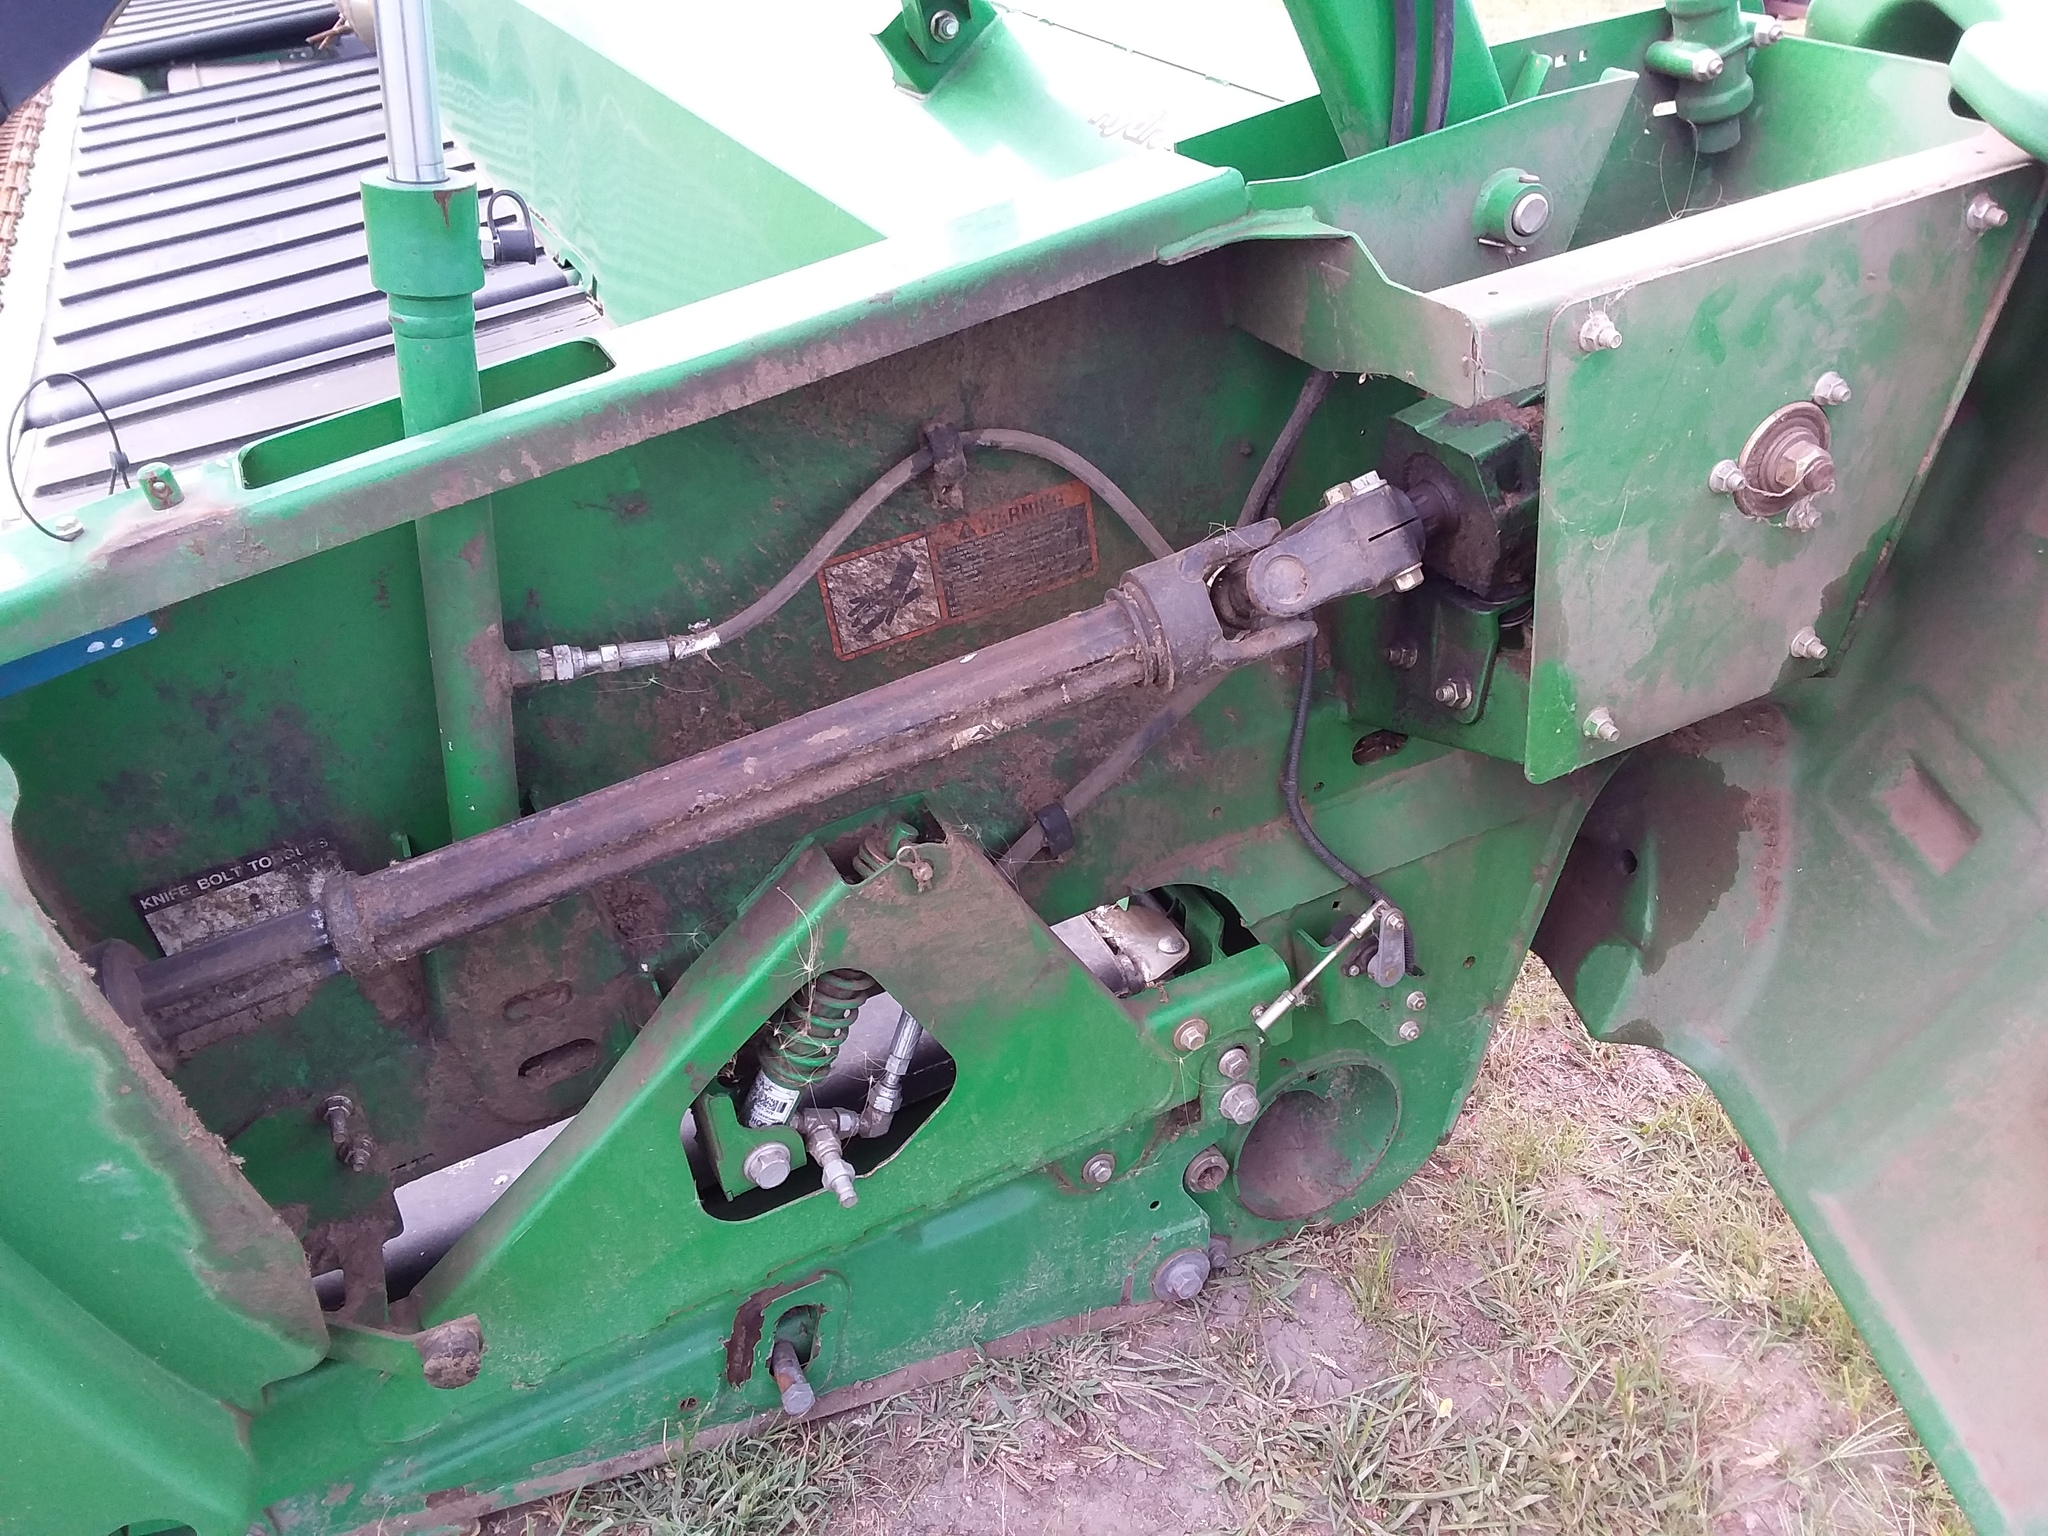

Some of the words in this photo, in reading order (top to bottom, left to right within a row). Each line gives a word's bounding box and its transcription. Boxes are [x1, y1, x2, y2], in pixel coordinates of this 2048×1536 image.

[980, 492, 1064, 531] RNING
[139, 884, 192, 911] KNIFE
[196, 864, 243, 892] BOLT
